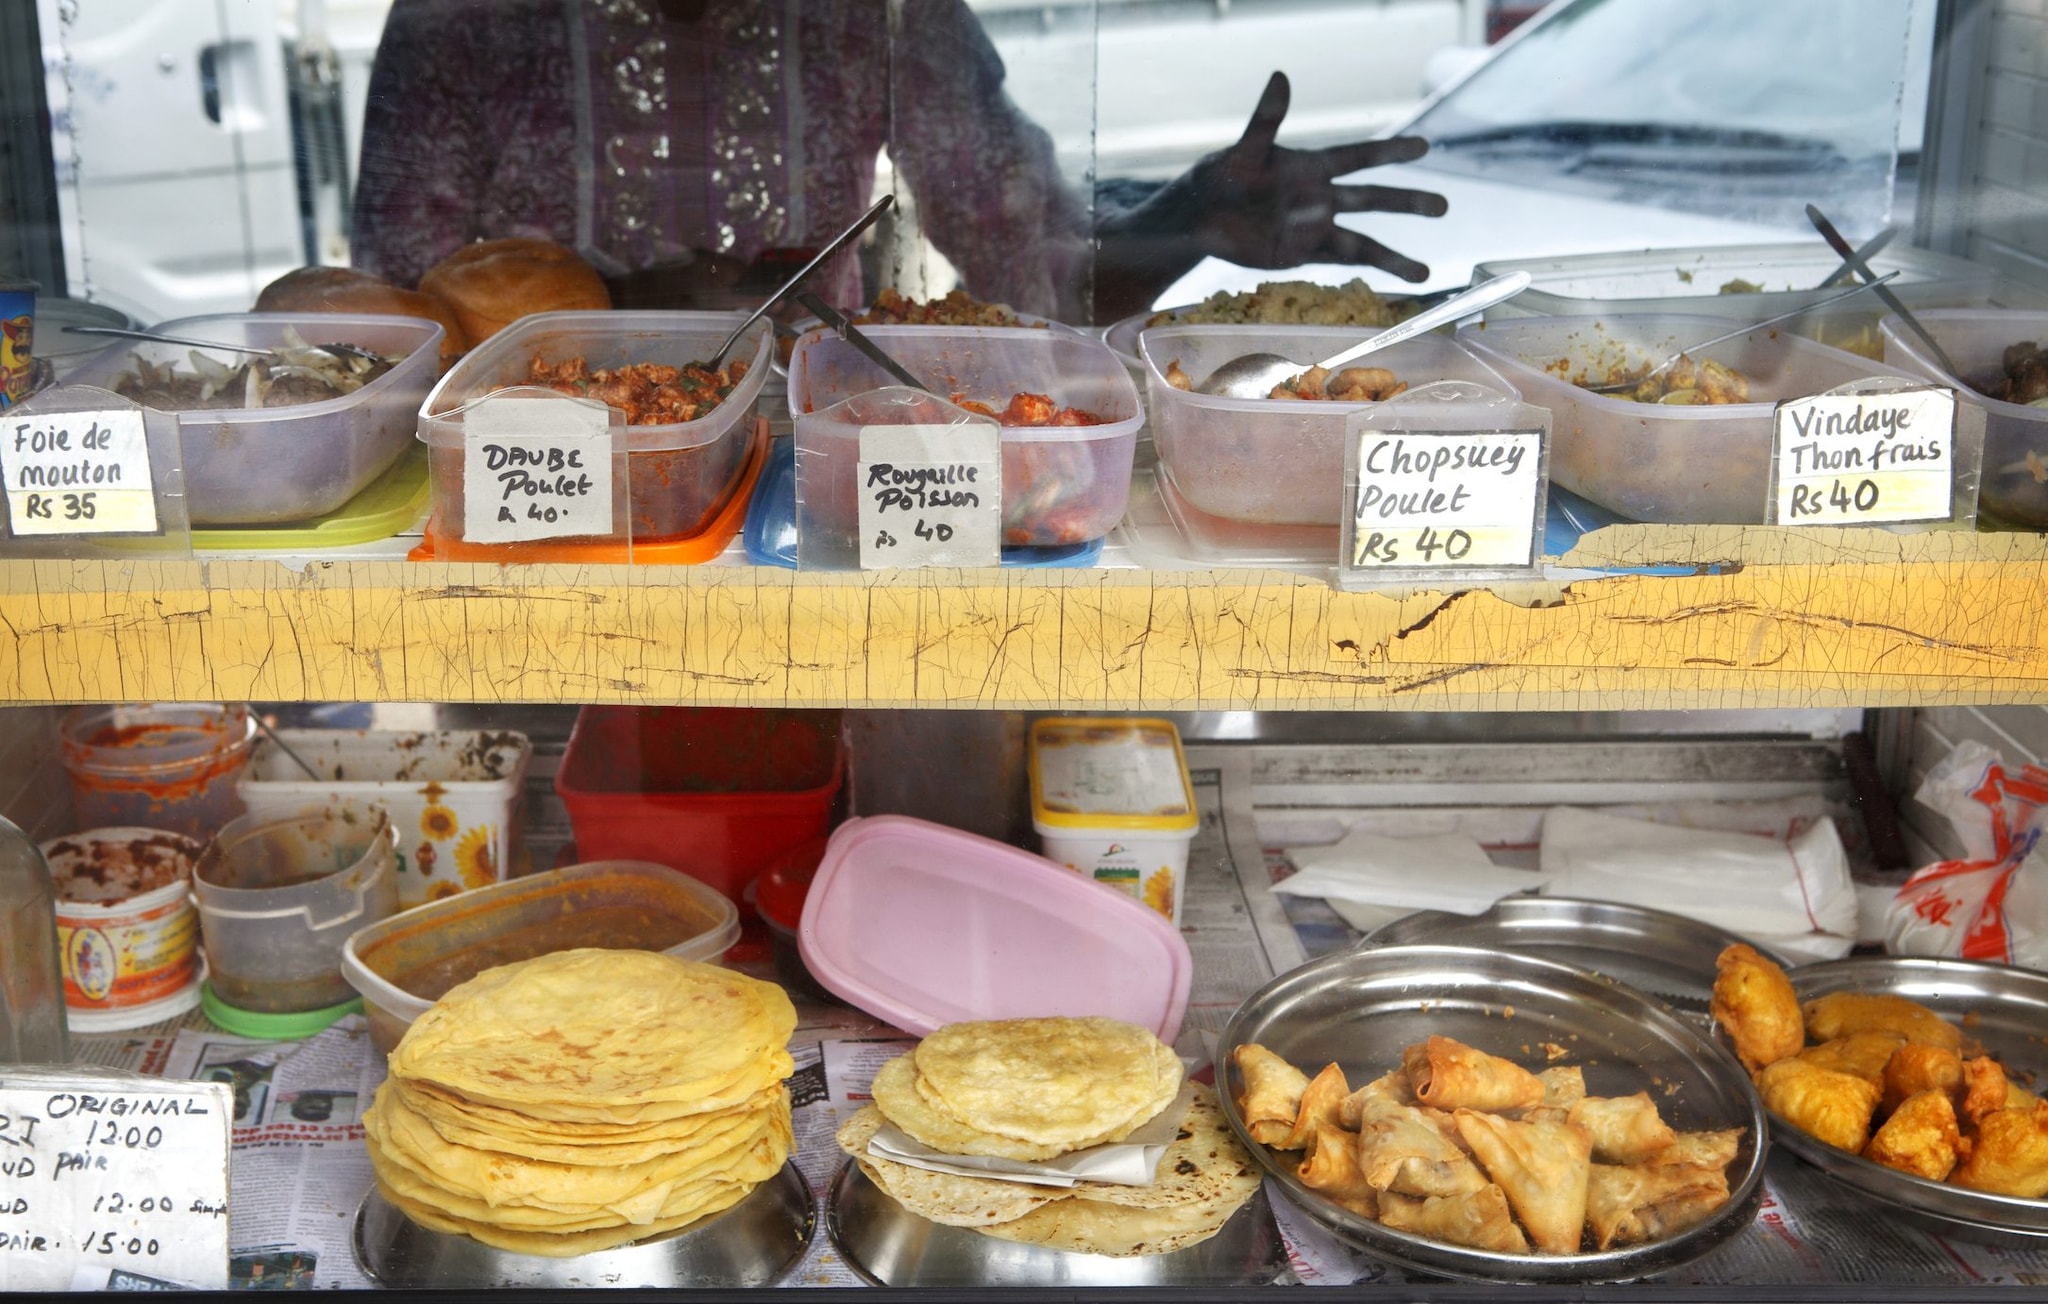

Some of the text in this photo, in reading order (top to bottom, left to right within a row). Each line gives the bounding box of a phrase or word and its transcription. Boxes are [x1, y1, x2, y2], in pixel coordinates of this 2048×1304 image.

[15, 422, 112, 453] Foie de
[1791, 404, 1912, 440] Vindaye
[482, 444, 584, 472] DAUBE
[1366, 438, 1526, 483] Chopsuey
[1790, 436, 1942, 474] Thon frais
[19, 460, 122, 487] mouton
[497, 469, 593, 501] Poulet
[26, 492, 97, 520] Rs 35
[1356, 483, 1472, 519] Poulet
[1790, 479, 1880, 518] Rs 40
[914, 518, 954, 542] 40
[1358, 526, 1472, 565] Rs 40
[46, 1093, 209, 1119] ORIGINAL
